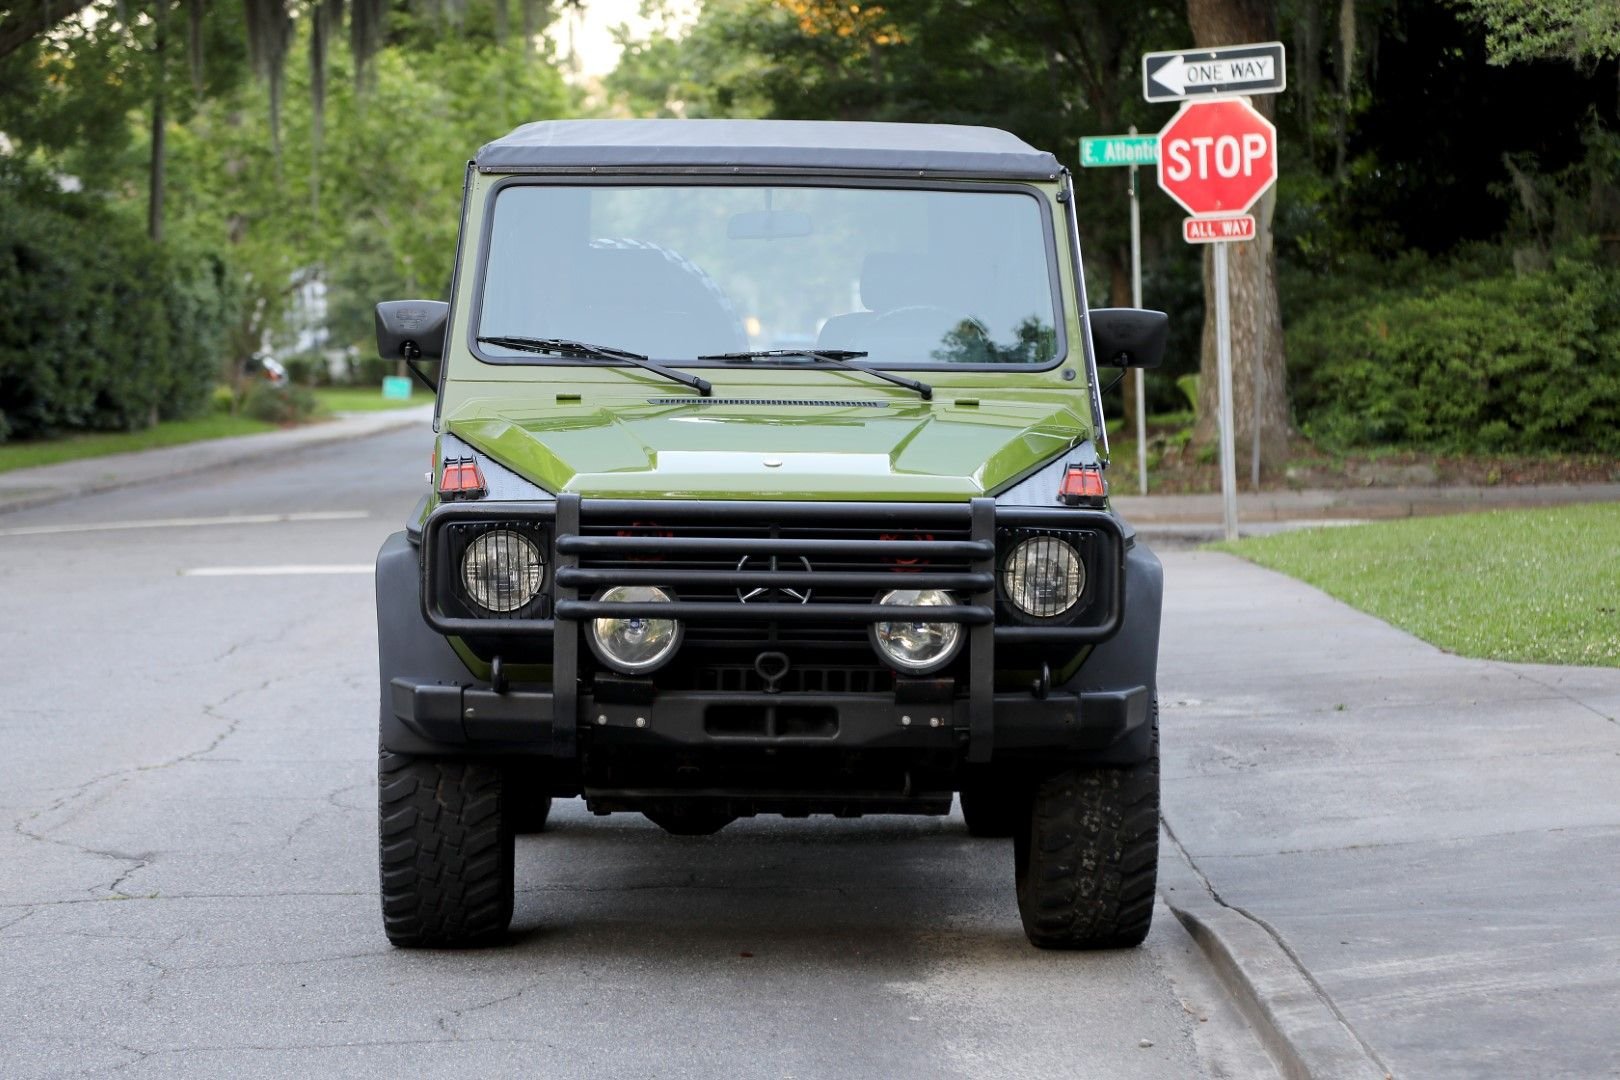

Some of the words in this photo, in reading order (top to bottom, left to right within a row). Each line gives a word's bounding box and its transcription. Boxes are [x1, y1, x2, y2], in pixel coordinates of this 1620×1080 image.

[1187, 64, 1222, 82] ONE
[1230, 61, 1267, 78] WAY
[1085, 141, 1099, 162] E.
[1167, 133, 1267, 181] STOP
[1190, 222, 1216, 237] ALL
[1222, 220, 1249, 235] WAY
